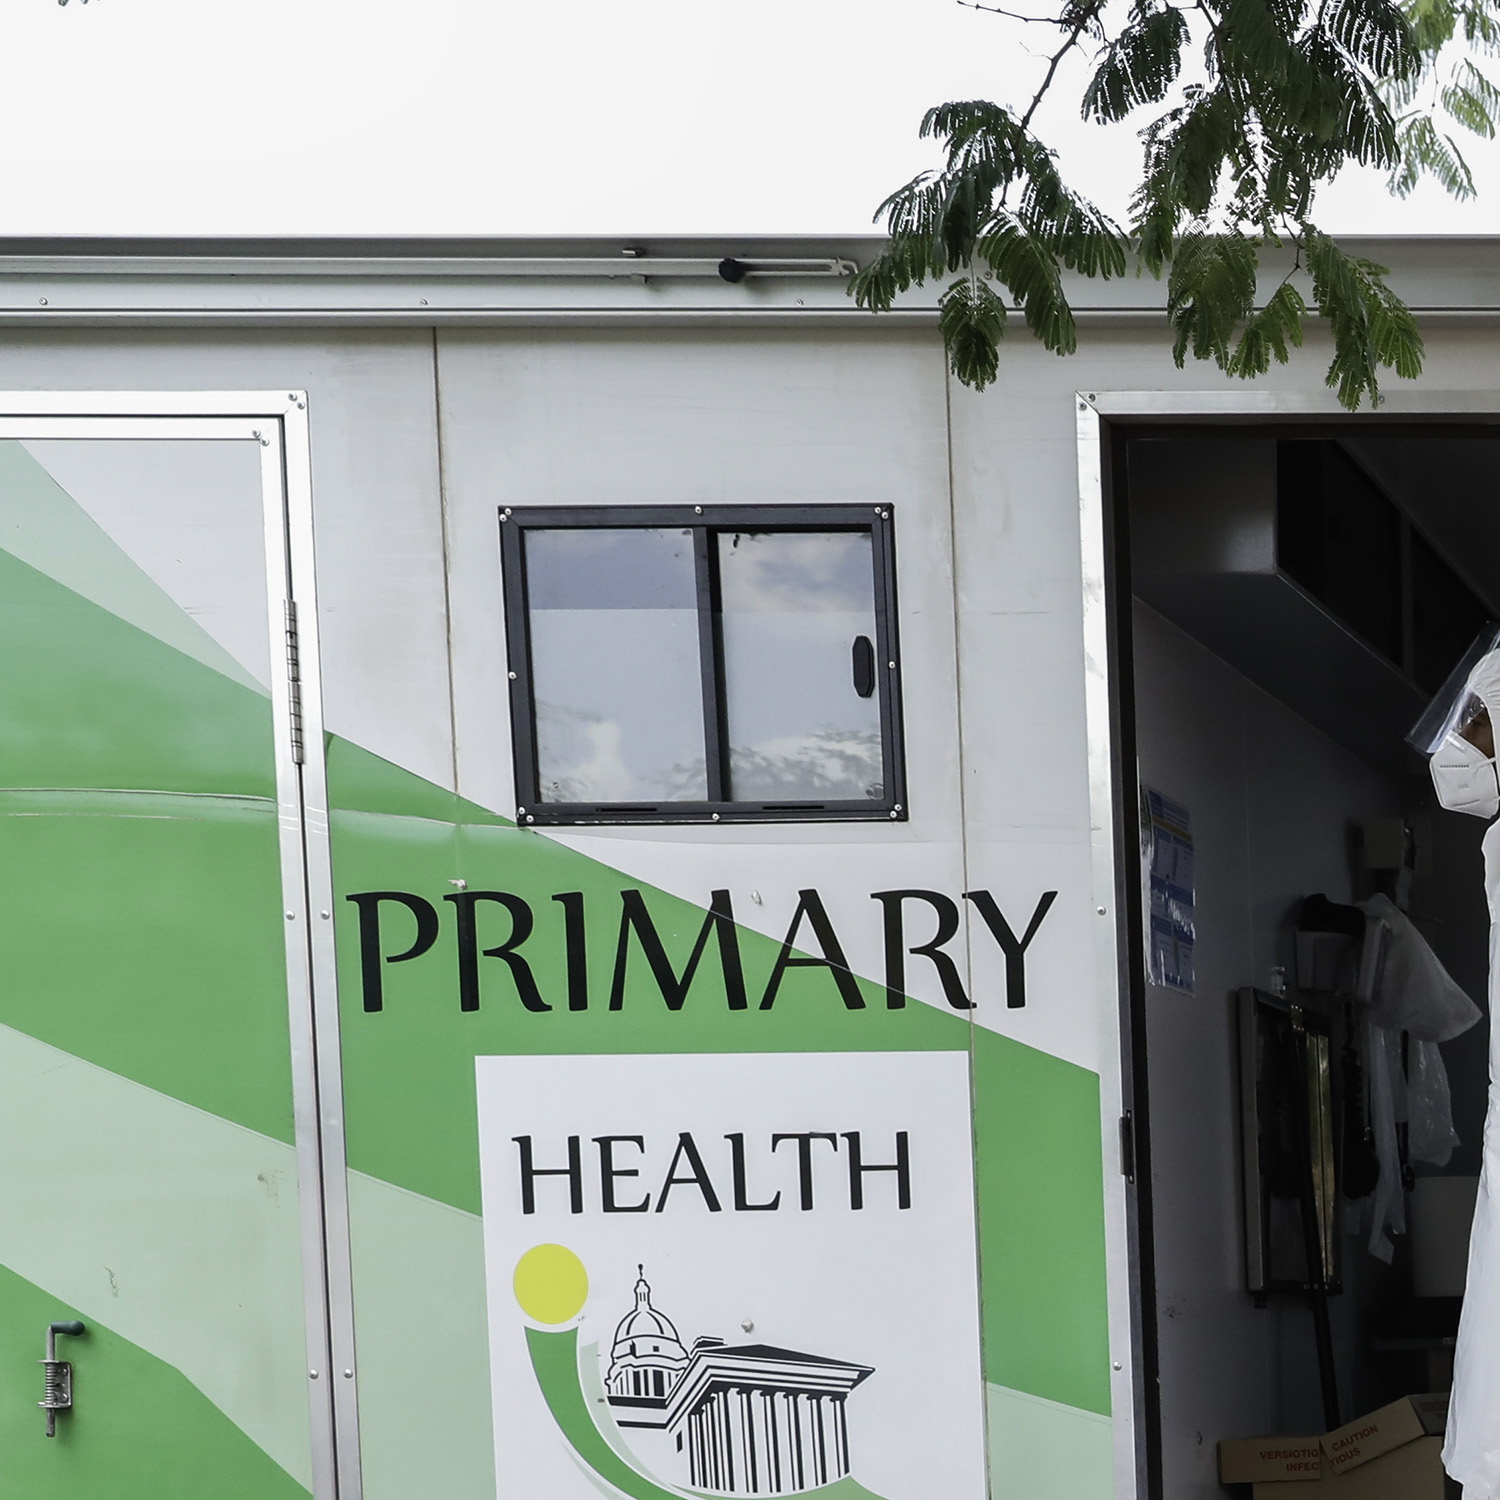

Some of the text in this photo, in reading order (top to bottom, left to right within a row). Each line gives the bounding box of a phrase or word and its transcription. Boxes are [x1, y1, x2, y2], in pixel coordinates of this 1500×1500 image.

[346, 888, 1058, 1013] PRIMARY
[511, 1130, 911, 1214] HEALTH
[1332, 1425, 1378, 1450] CAUTION
[1285, 1462, 1320, 1472] INFEC
